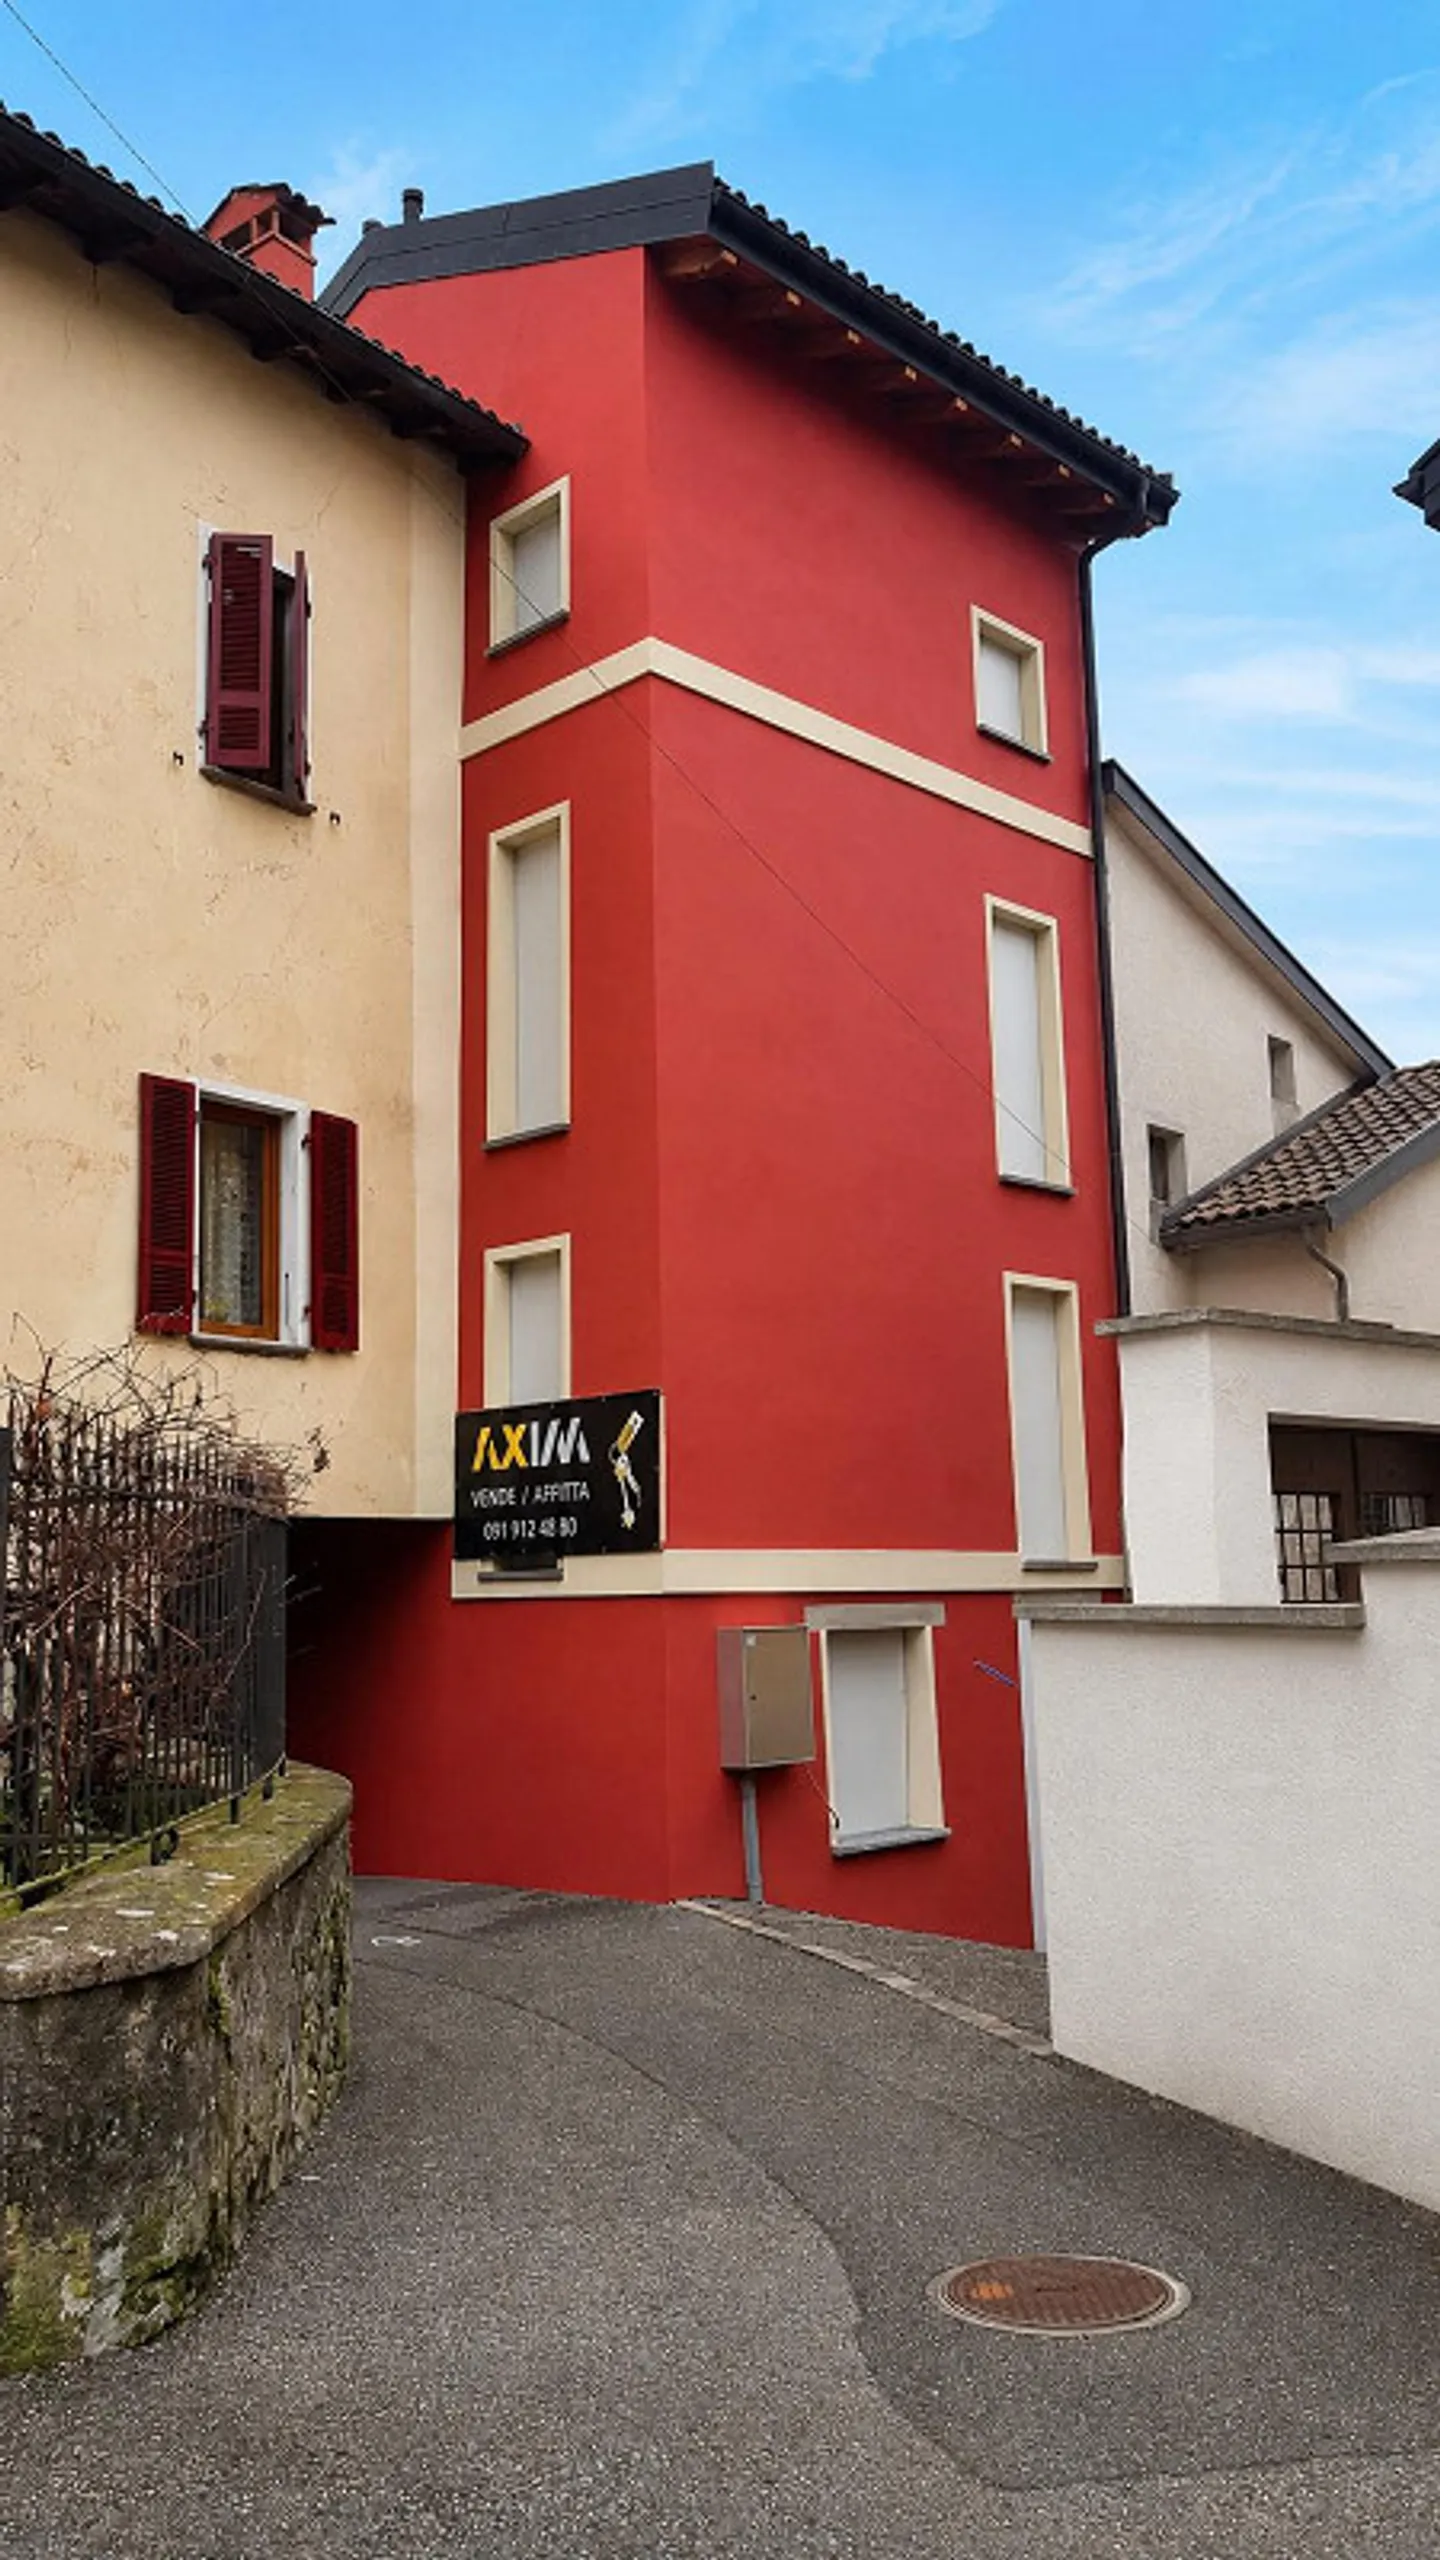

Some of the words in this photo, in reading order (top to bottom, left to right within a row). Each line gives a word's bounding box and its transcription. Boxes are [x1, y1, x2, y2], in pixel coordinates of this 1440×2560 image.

[472, 1417, 591, 1471] AXIM
[470, 1487, 516, 1508] VENDE
[521, 1485, 530, 1506] /
[532, 1481, 590, 1504] AFFITTA
[483, 1521, 507, 1540] 091
[510, 1519, 536, 1539] 912
